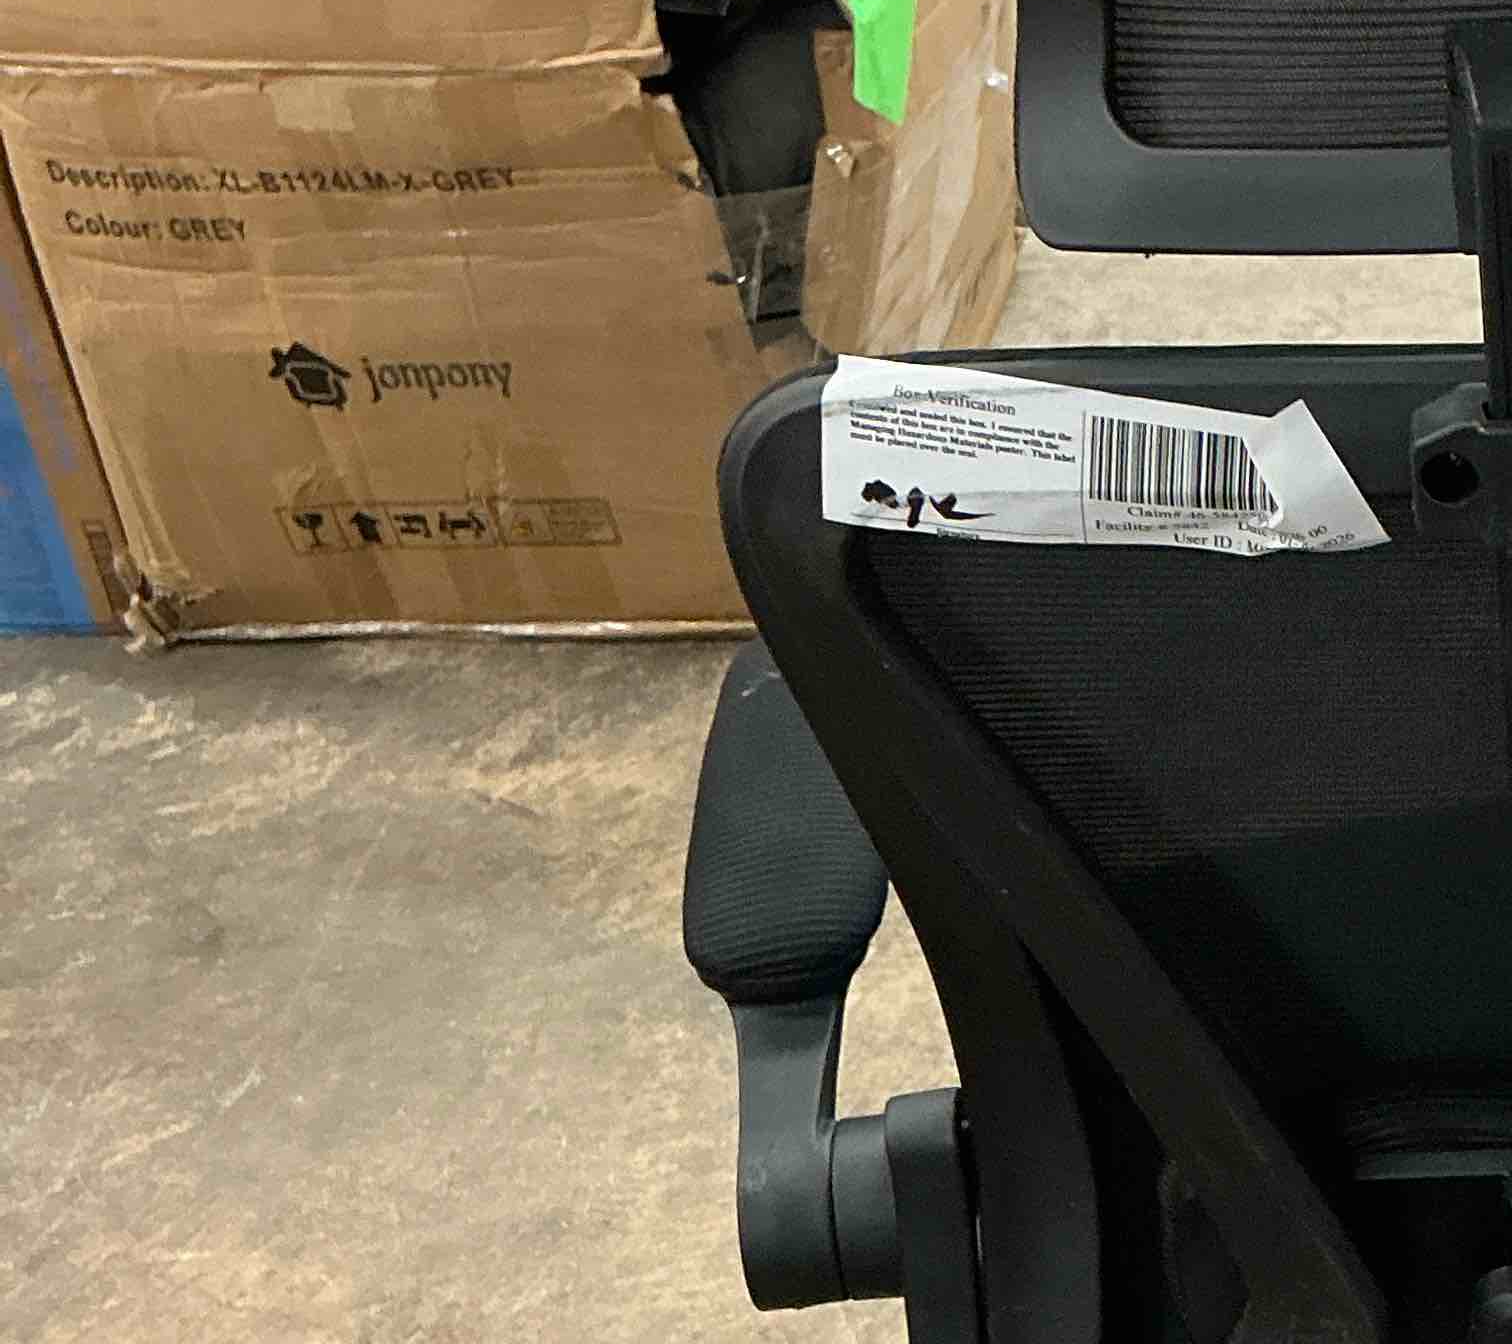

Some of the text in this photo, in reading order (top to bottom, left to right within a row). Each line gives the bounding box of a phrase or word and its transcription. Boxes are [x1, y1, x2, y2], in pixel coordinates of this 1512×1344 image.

[46, 158, 210, 197] Description:
[65, 208, 245, 241] Colour: GREY
[360, 356, 512, 403] jonpony
[928, 389, 1017, 416] Verification
[1173, 532, 1209, 545] User
[1213, 535, 1233, 549] ID
